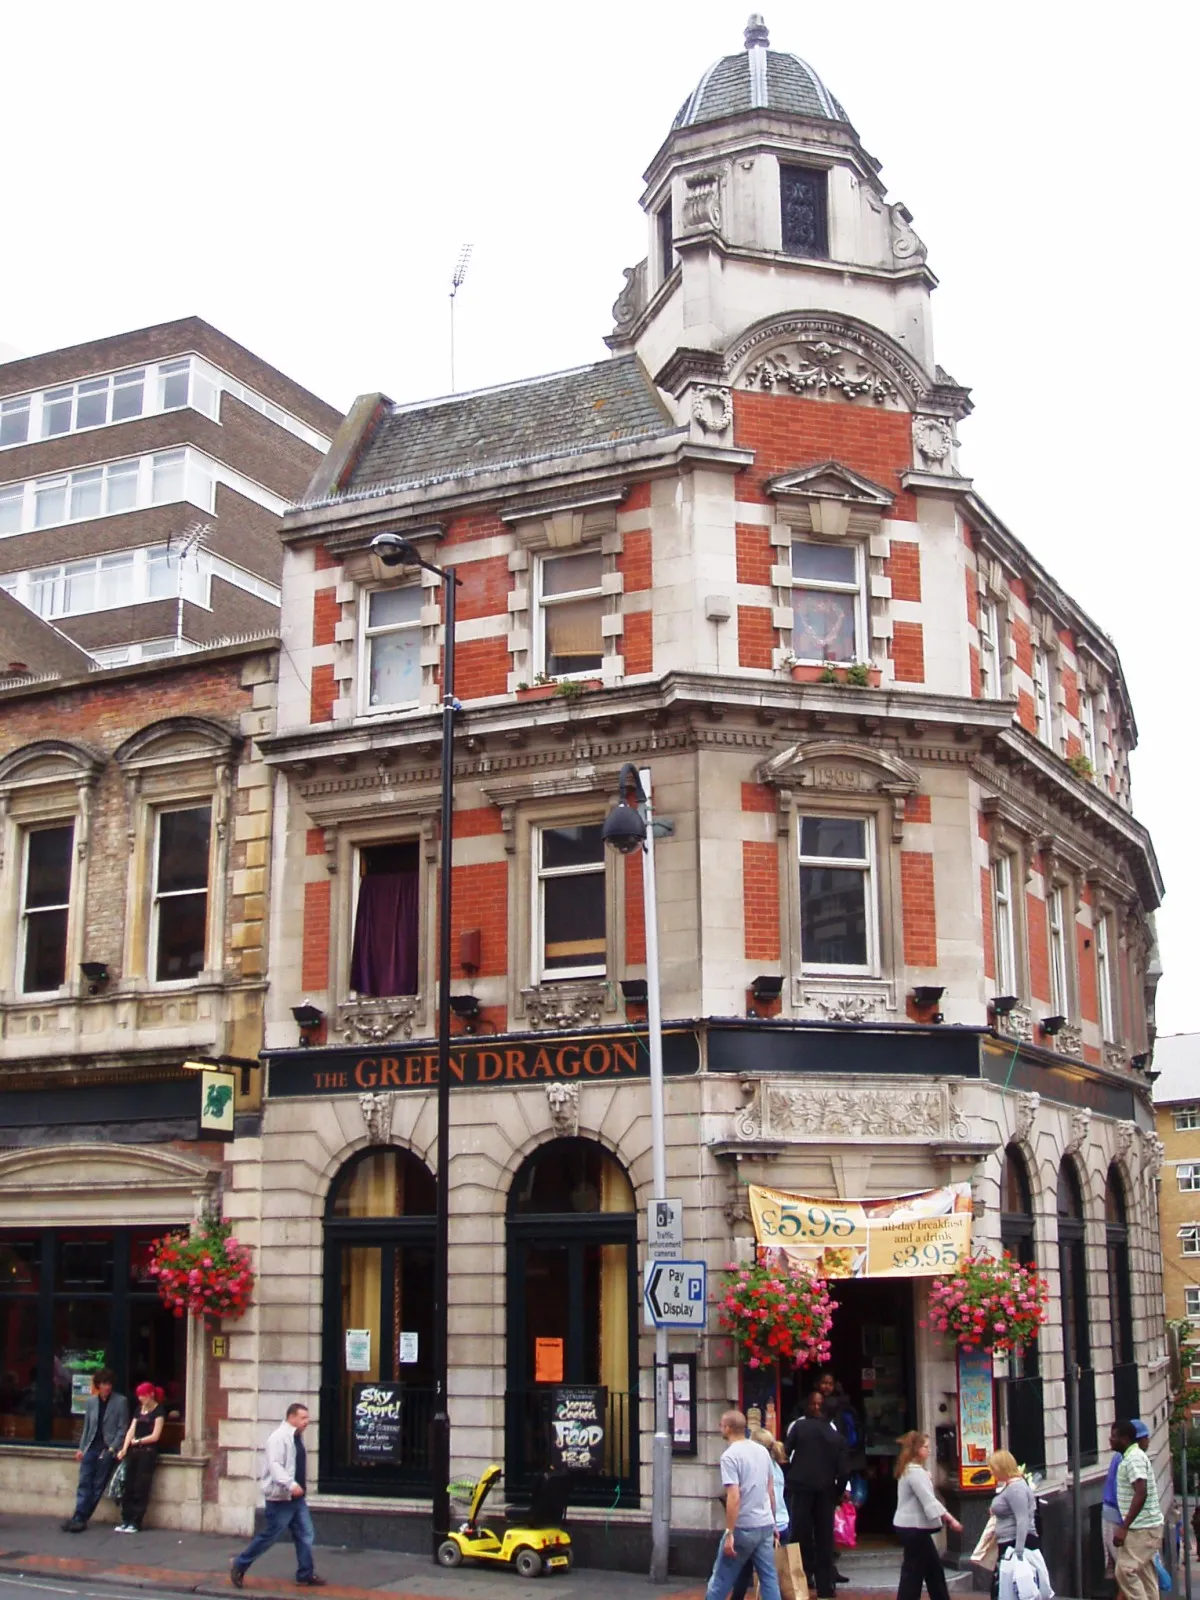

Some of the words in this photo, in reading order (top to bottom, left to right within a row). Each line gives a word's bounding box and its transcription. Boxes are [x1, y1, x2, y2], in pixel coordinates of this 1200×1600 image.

[818, 767, 855, 786] 1909
[314, 1071, 348, 1088] THE
[354, 1053, 467, 1088] GREEN
[476, 1042, 638, 1080] DRAGON
[761, 1205, 856, 1237] £5.95
[882, 1221, 914, 1232] all-day
[917, 1219, 963, 1231] breakfast
[656, 1231, 674, 1240] Traffic
[894, 1233, 913, 1243] and
[923, 1231, 952, 1242] drink
[649, 1240, 682, 1249] enforcement
[654, 1249, 677, 1258] cameras
[893, 1243, 958, 1268] £3.95
[668, 1269, 685, 1284] Pay
[673, 1285, 681, 1298] &
[690, 1280, 701, 1299] P
[662, 1301, 695, 1318] Display
[214, 1338, 225, 1354] H
[360, 1388, 394, 1406] Sky
